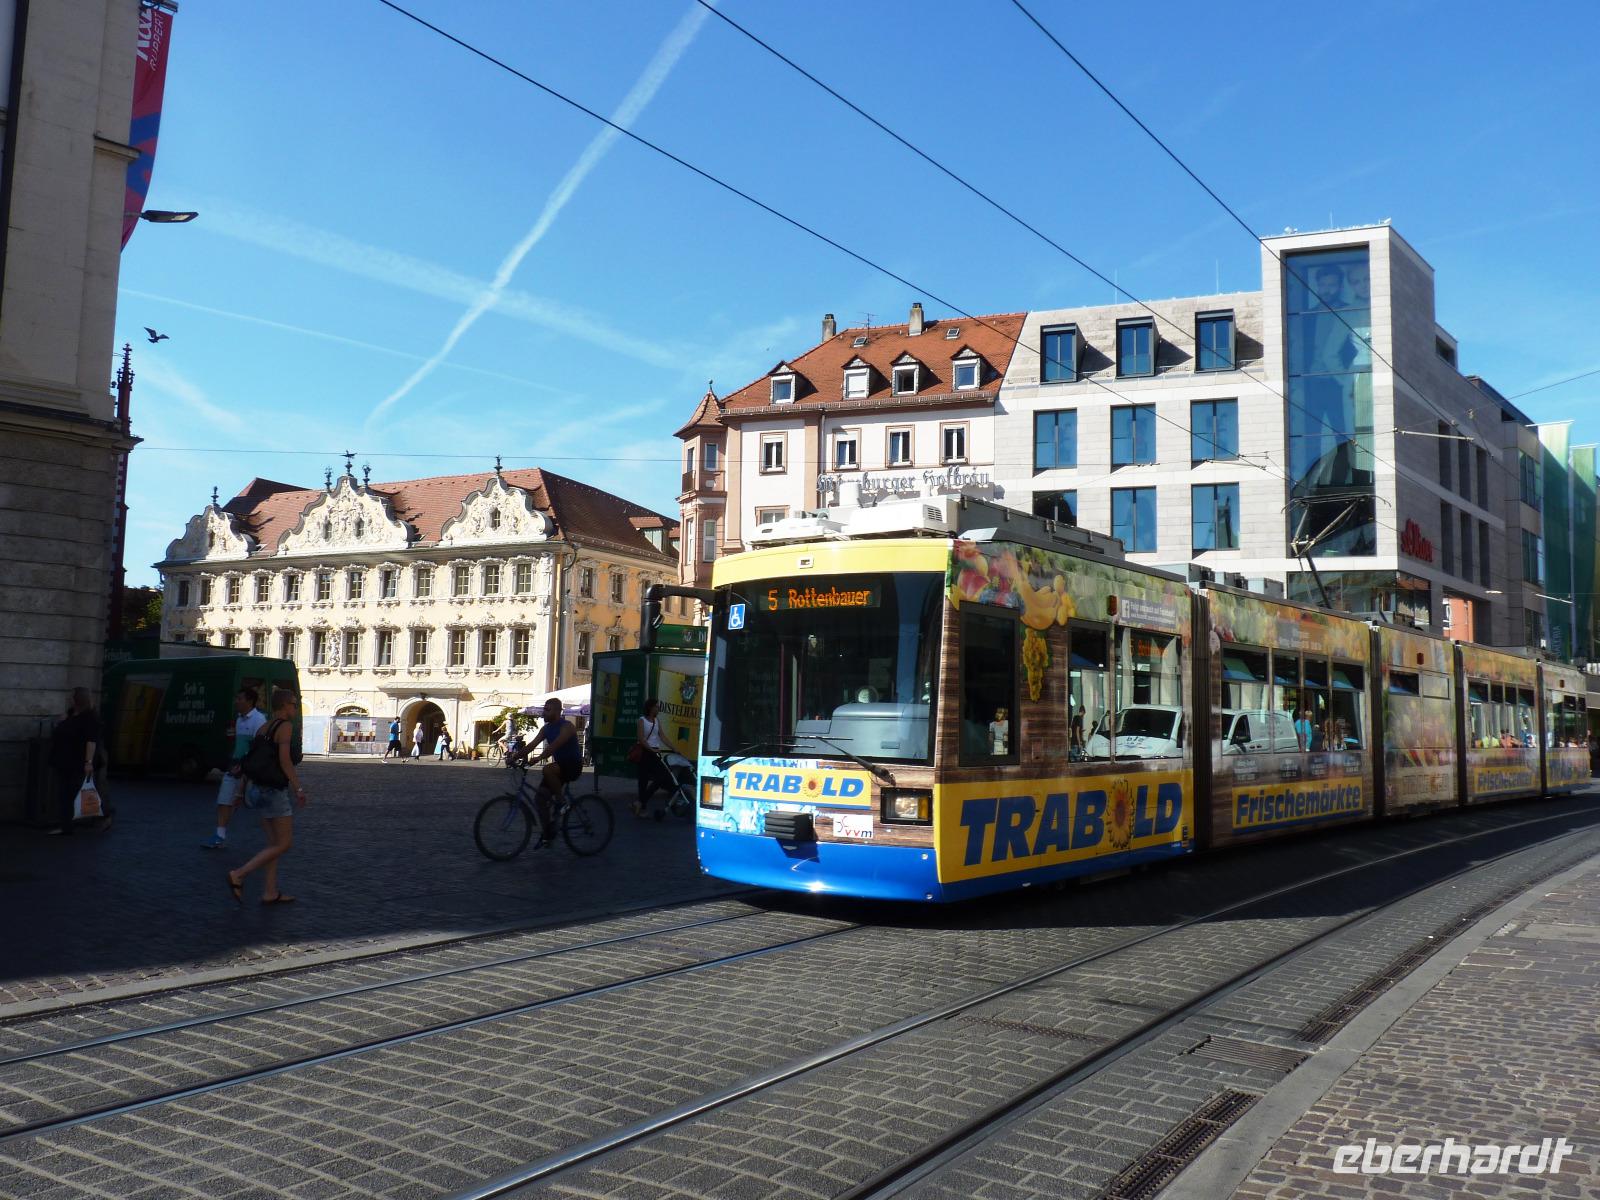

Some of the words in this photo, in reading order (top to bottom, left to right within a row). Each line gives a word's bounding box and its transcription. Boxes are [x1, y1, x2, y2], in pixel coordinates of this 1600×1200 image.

[150, 11, 164, 71] RUPPERT
[767, 589, 778, 611] 5
[788, 586, 871, 608] Rottenbauer
[1236, 784, 1361, 825] Frischemärkte
